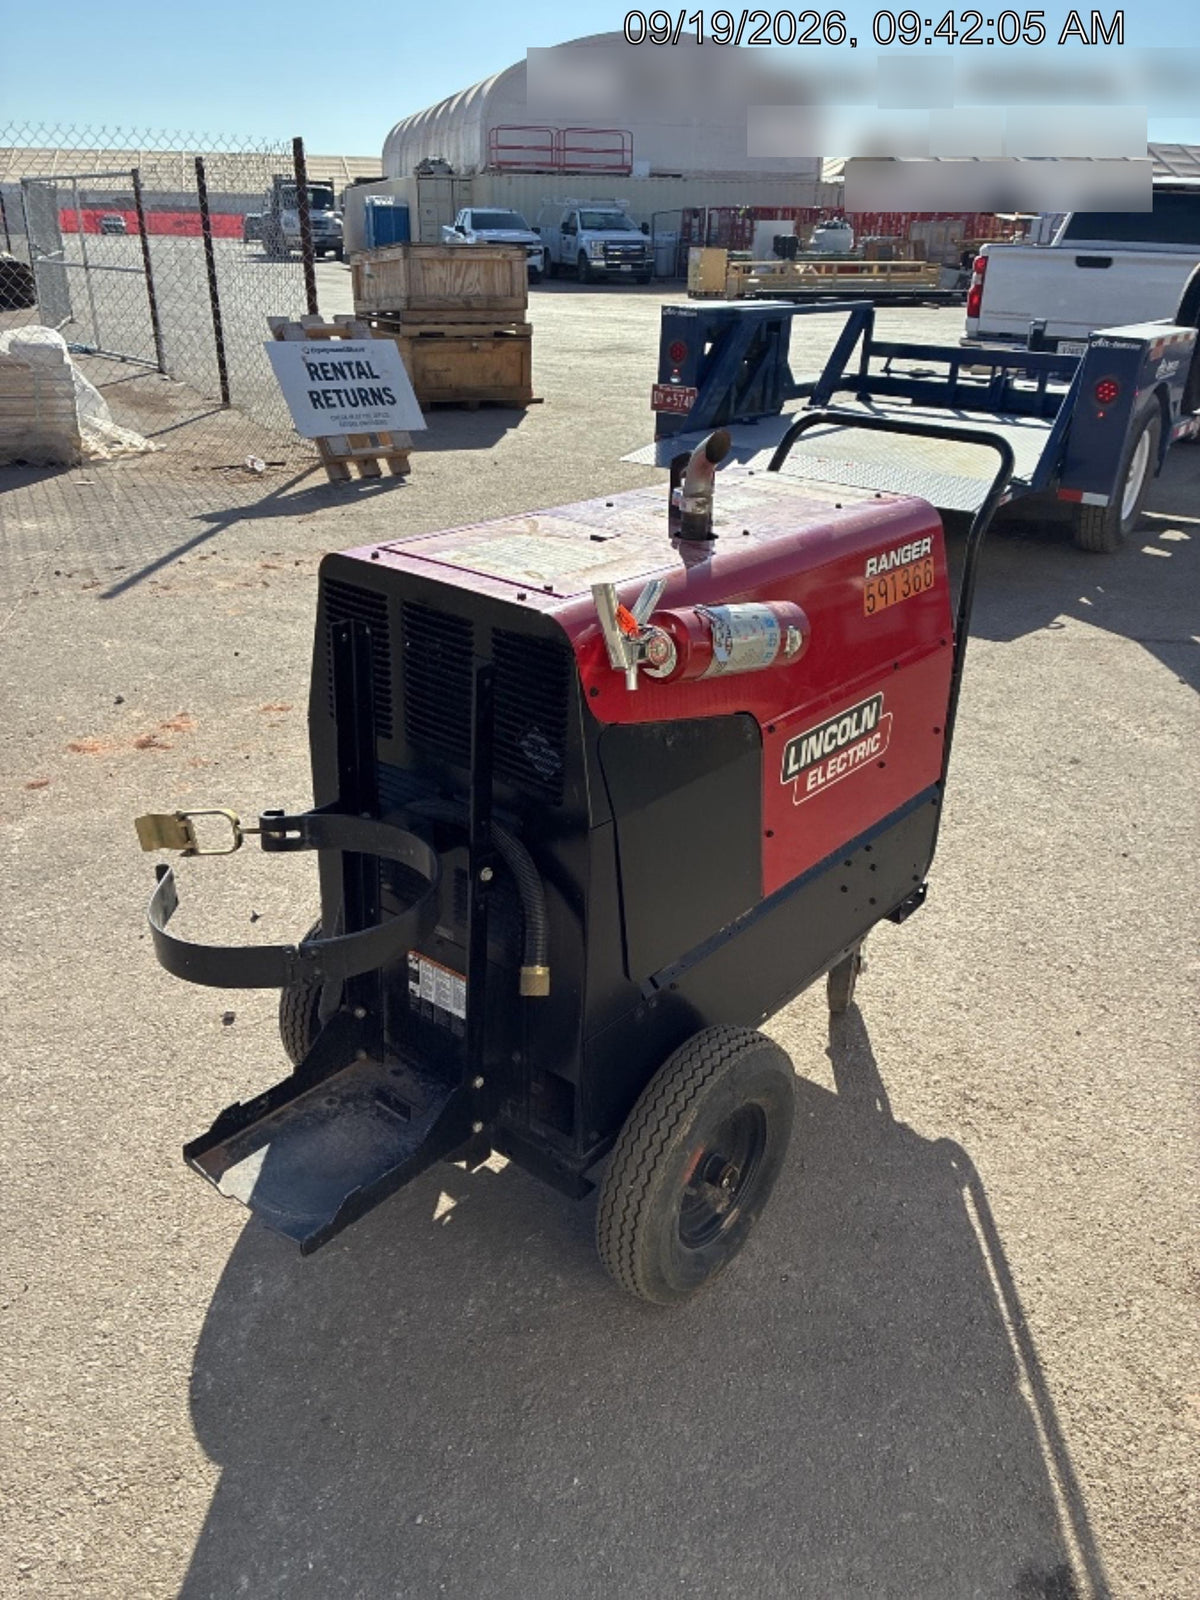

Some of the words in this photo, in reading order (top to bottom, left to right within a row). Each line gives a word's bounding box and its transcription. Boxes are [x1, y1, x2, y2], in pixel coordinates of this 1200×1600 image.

[306, 361, 380, 381] RENTAL
[308, 387, 397, 410] RETURNS
[865, 536, 932, 579] RANGER
[865, 558, 933, 614] 591366
[787, 701, 878, 776] LINCOLN
[806, 731, 881, 792] ELECTRIC
